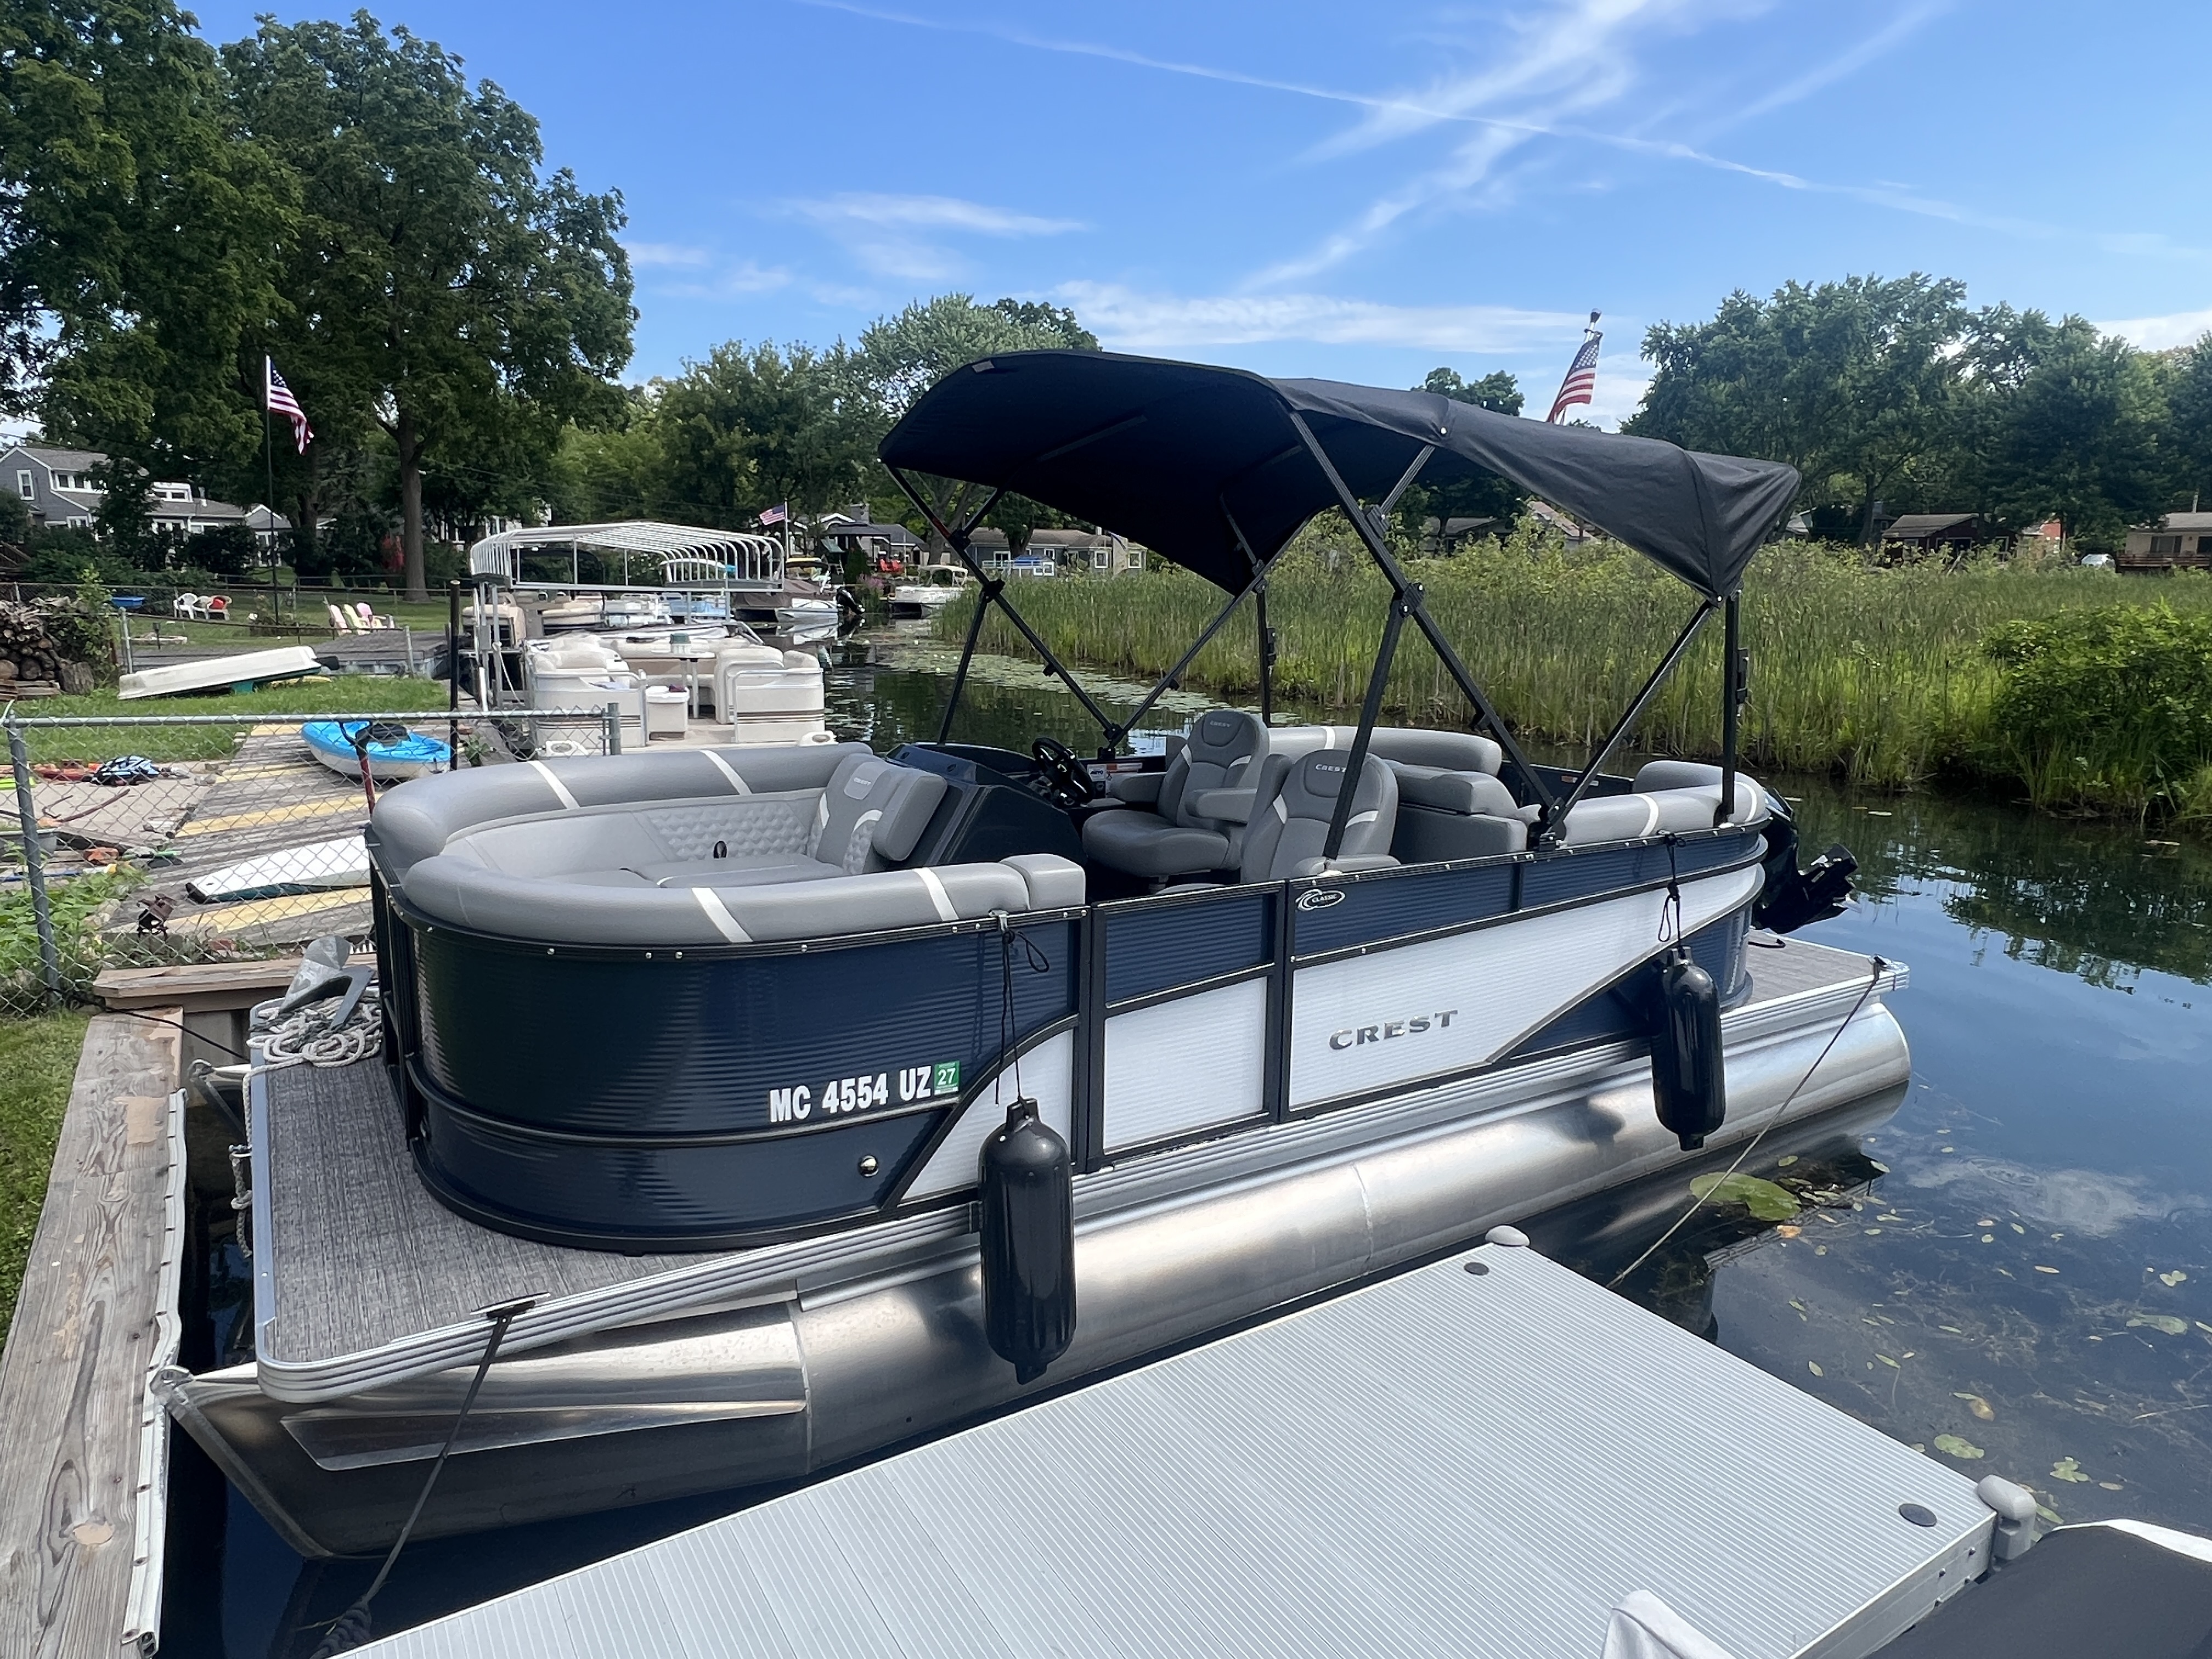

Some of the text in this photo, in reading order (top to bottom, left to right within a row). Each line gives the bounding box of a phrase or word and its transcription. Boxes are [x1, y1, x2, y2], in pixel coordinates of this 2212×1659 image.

[1316, 764, 1346, 772] CREST
[1329, 1009, 1458, 1050] CREST
[937, 1068, 956, 1085] 27
[769, 1065, 932, 1122] MC 4554 UZ
